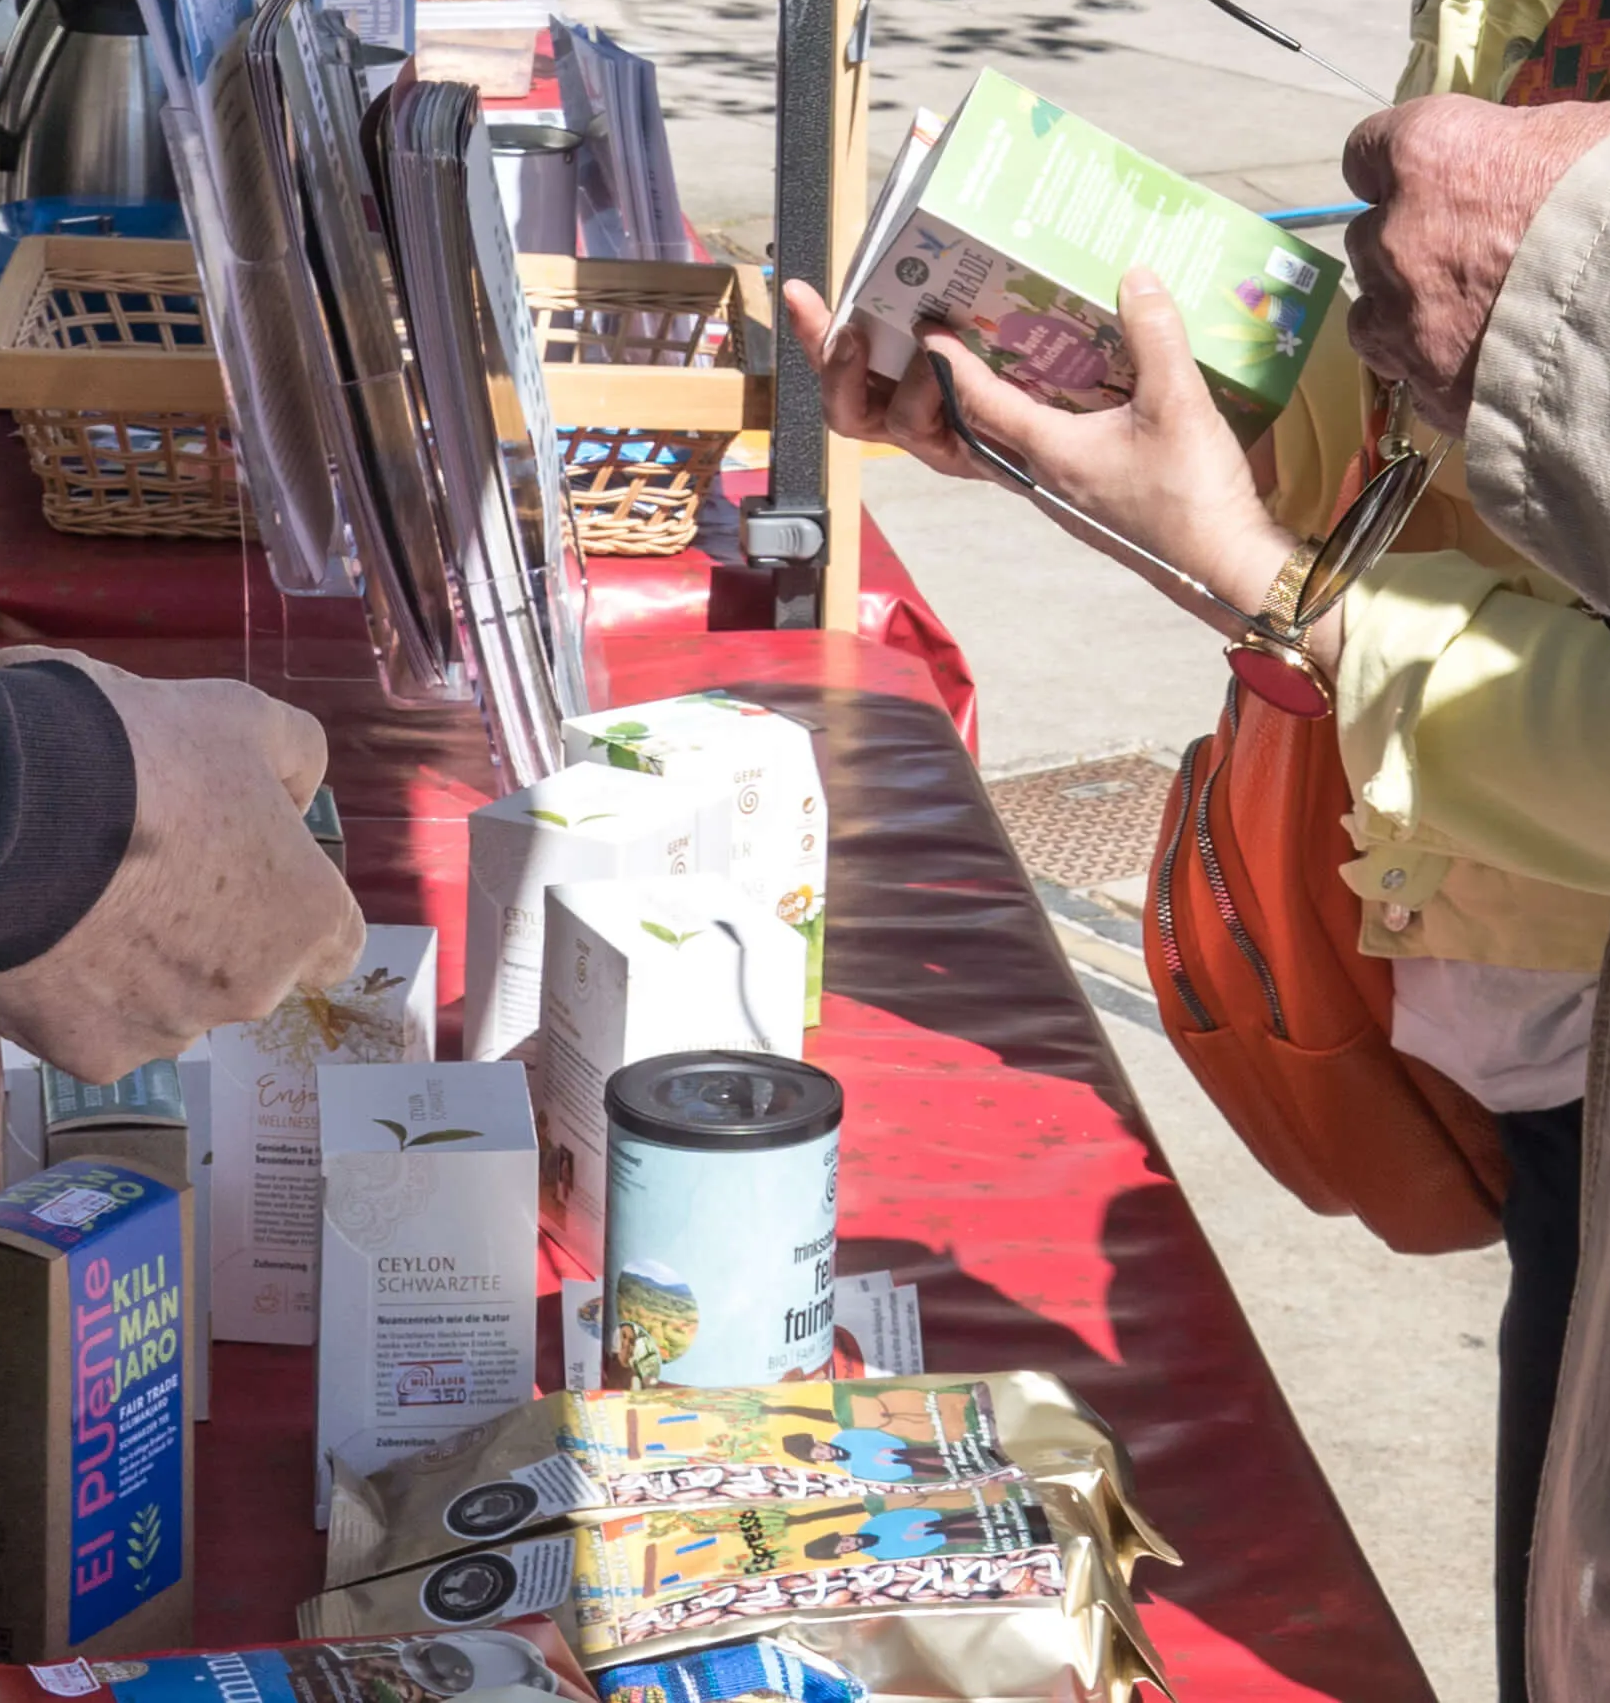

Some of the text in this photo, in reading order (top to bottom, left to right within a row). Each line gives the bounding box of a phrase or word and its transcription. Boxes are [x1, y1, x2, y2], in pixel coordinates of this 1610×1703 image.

[942, 247, 994, 311] TRADE
[733, 767, 763, 784] GEPA
[667, 836, 689, 857] GEPA
[111, 1254, 166, 1315] KILI
[377, 1255, 456, 1274] CEYLON
[377, 1273, 502, 1294] SCHWARZTEE
[118, 1285, 180, 1351] MAN
[445, 1314, 462, 1324] wie
[464, 1313, 481, 1324] die
[482, 1312, 510, 1324] Natur
[109, 1327, 178, 1404] JARO
[118, 1373, 180, 1421] FAIR TRADE
[737, 1508, 776, 1574] Espresso
